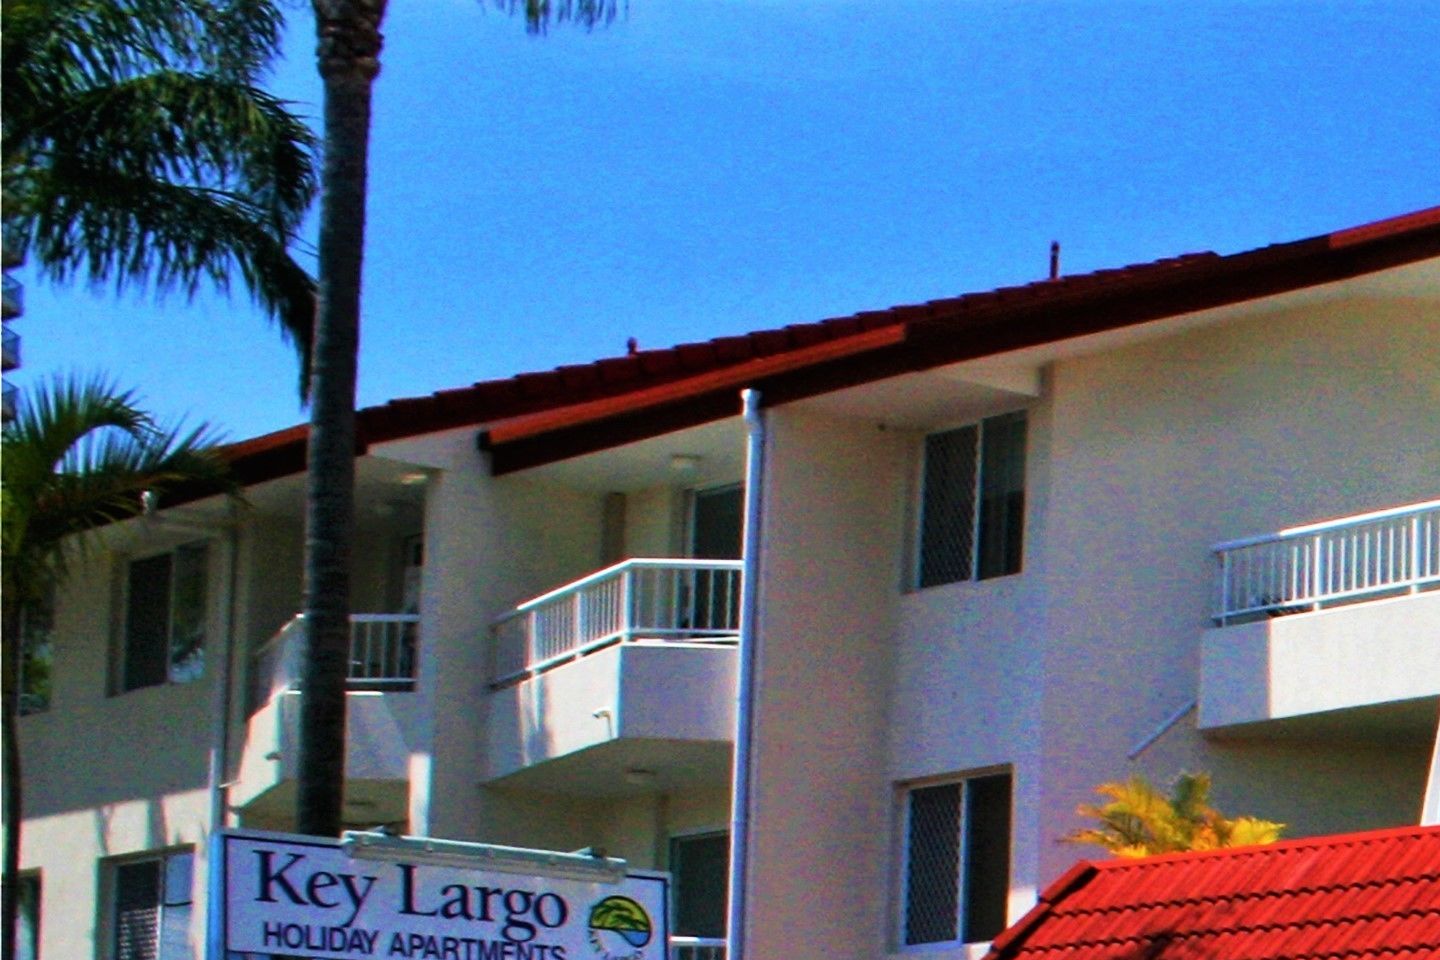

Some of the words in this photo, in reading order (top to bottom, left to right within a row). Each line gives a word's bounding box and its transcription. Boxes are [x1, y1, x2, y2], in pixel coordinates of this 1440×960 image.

[253, 850, 377, 928] Key
[397, 864, 568, 942] Largo
[263, 921, 379, 954] HOLIDAY
